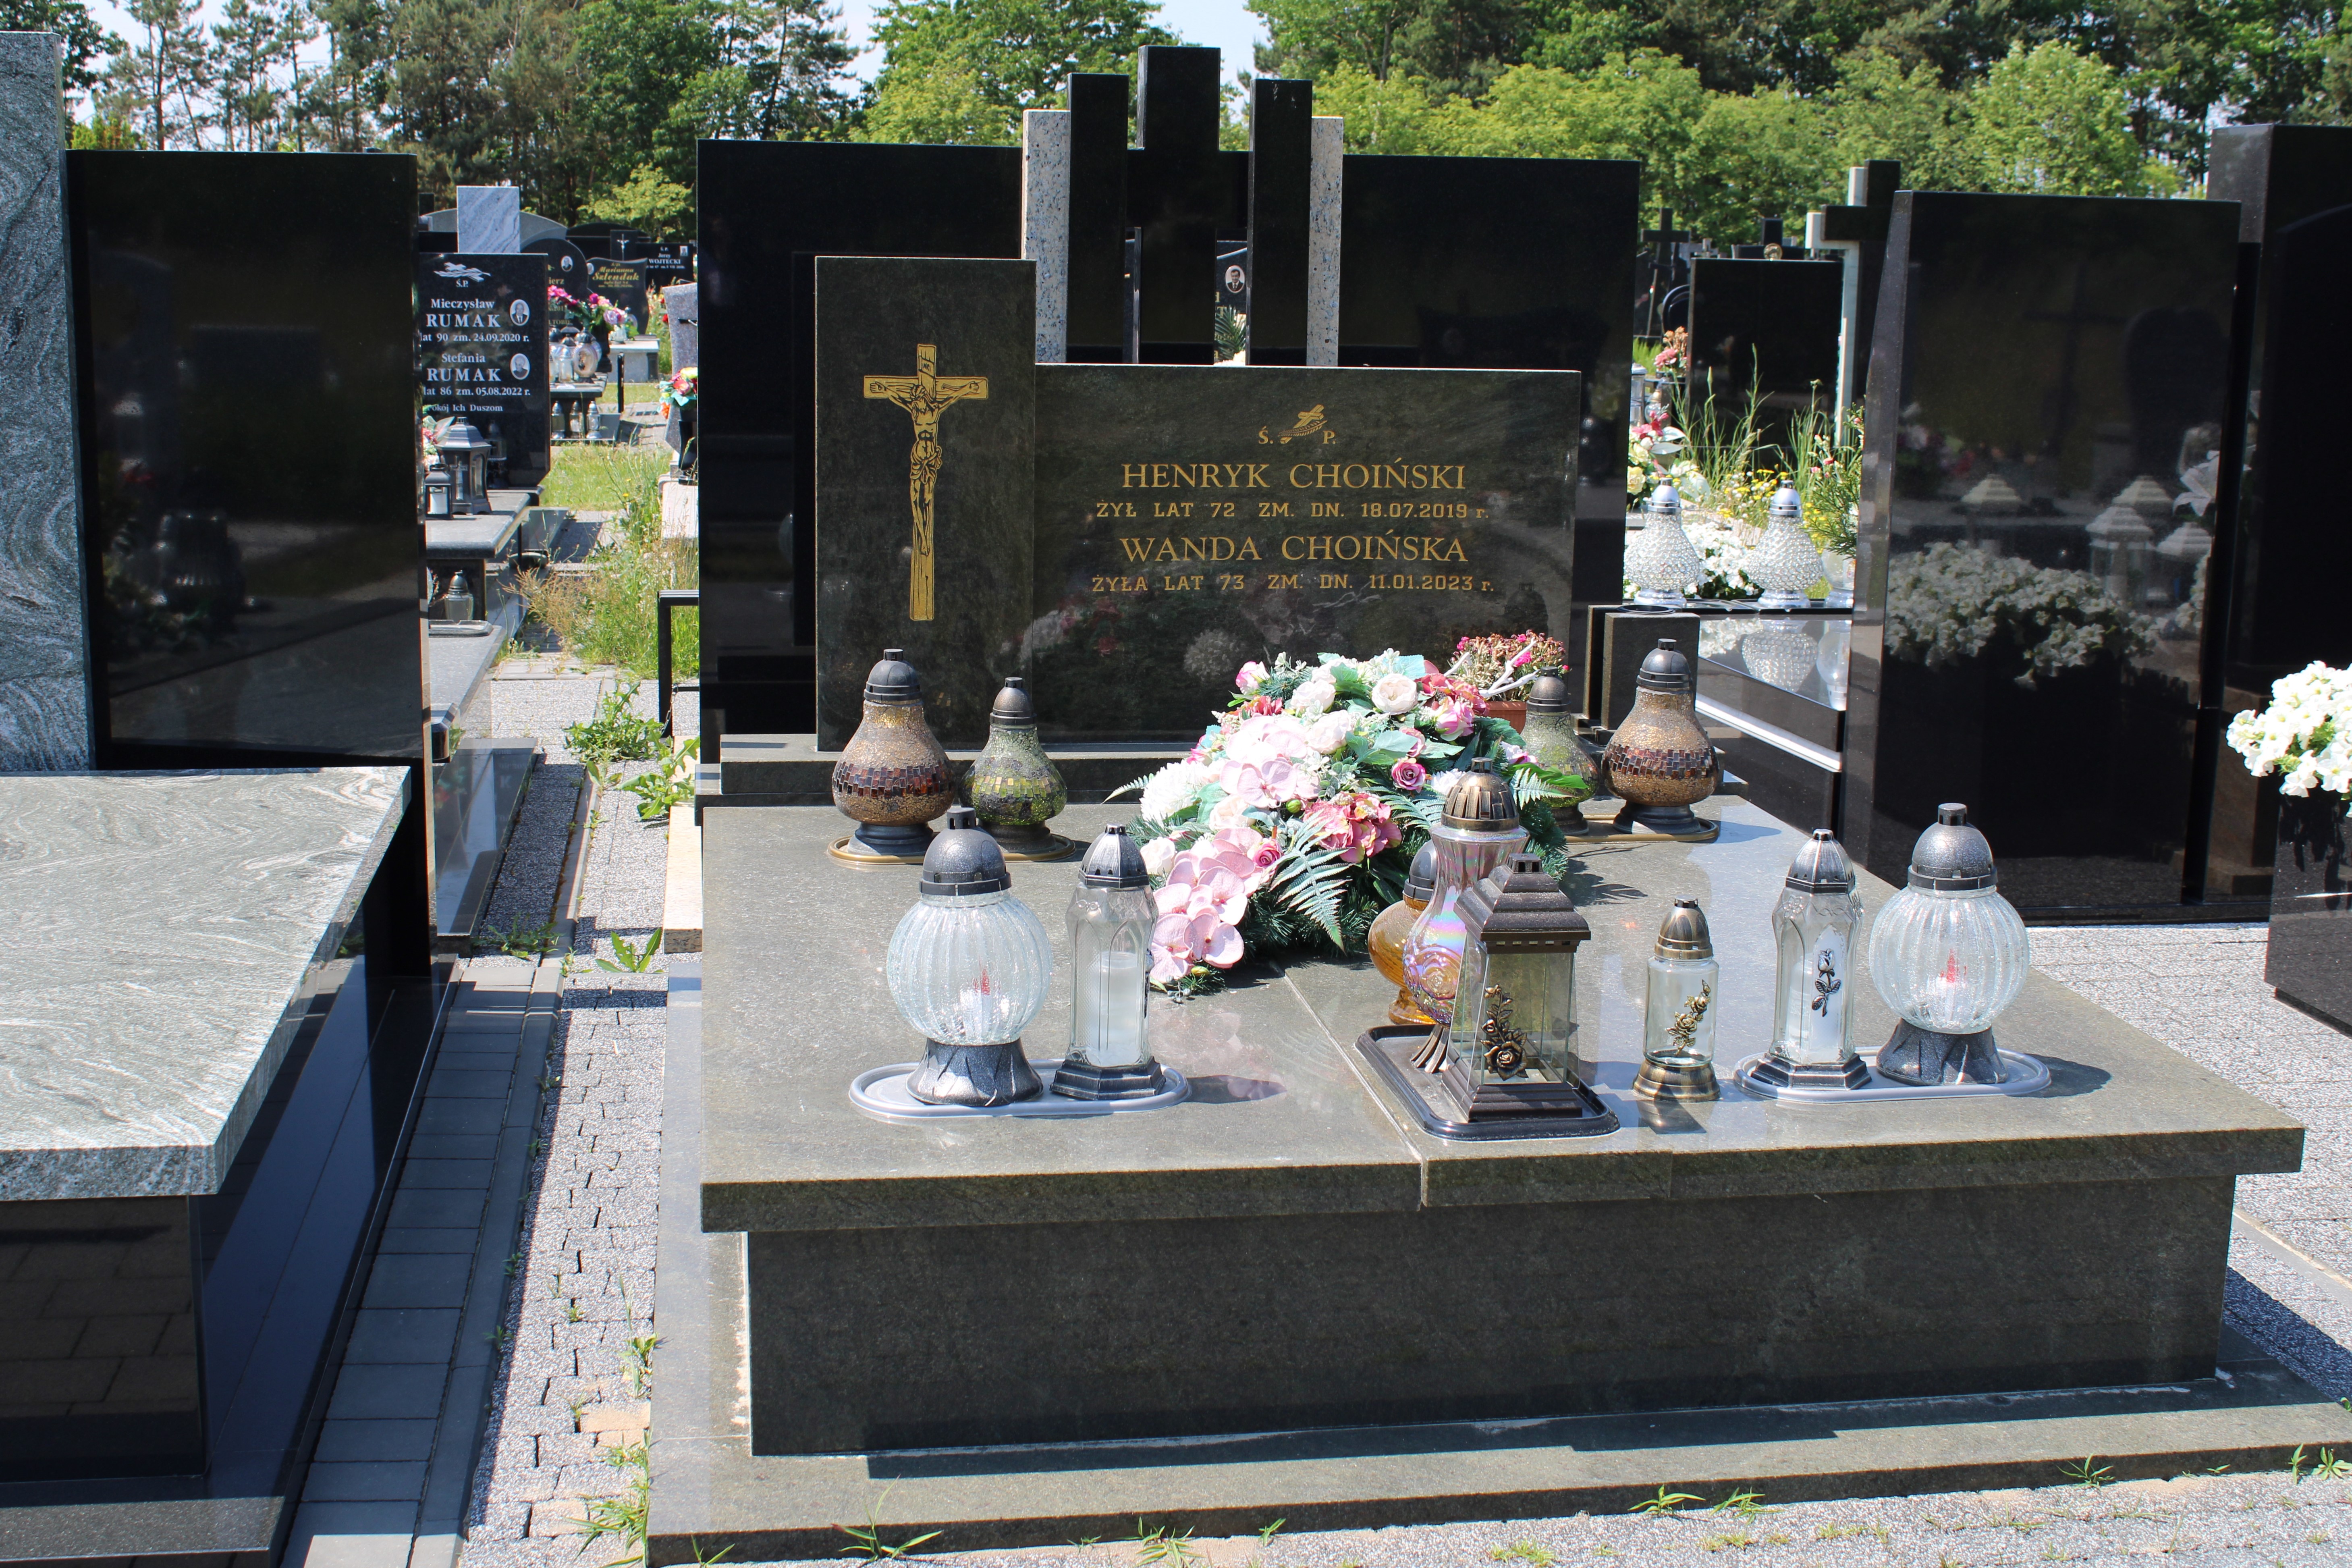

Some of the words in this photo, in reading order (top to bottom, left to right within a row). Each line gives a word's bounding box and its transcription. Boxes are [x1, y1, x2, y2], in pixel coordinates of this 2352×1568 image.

[592, 272, 639, 280] Szlendak
[431, 299, 495, 311] Mieczysław
[426, 314, 501, 327] RUMAK
[437, 333, 448, 341] 90
[473, 333, 520, 342] 24.09.2020
[442, 353, 486, 363] Stefania
[427, 368, 501, 381] RUMAK
[423, 386, 435, 395] lat
[440, 386, 451, 395] 86
[476, 387, 522, 396] 05.08.2022
[1258, 426, 1274, 444] Ś.
[1322, 430, 1336, 444] P.
[1122, 463, 1270, 488] HENRYK
[1289, 457, 1466, 489] CHOIŃSKI
[1096, 498, 1137, 517] ŻYŁ
[1154, 502, 1194, 517] LAT
[1210, 502, 1235, 517] 72
[1258, 502, 1295, 517] ZM.
[1311, 502, 1344, 517] DN.
[1362, 502, 1468, 518] 18.07.2019
[1476, 508, 1489, 519] r.
[1119, 536, 1262, 561] WANDA
[1281, 529, 1468, 561] CHOIŃSKA
[1092, 573, 1148, 592] ŻYŁA
[1164, 575, 1204, 590] LAT
[1220, 575, 1245, 590] 73
[1268, 574, 1304, 590] ZM.
[1320, 574, 1353, 589] DN.
[1370, 574, 1473, 590] 11.01.2023
[1481, 581, 1495, 591] r.
